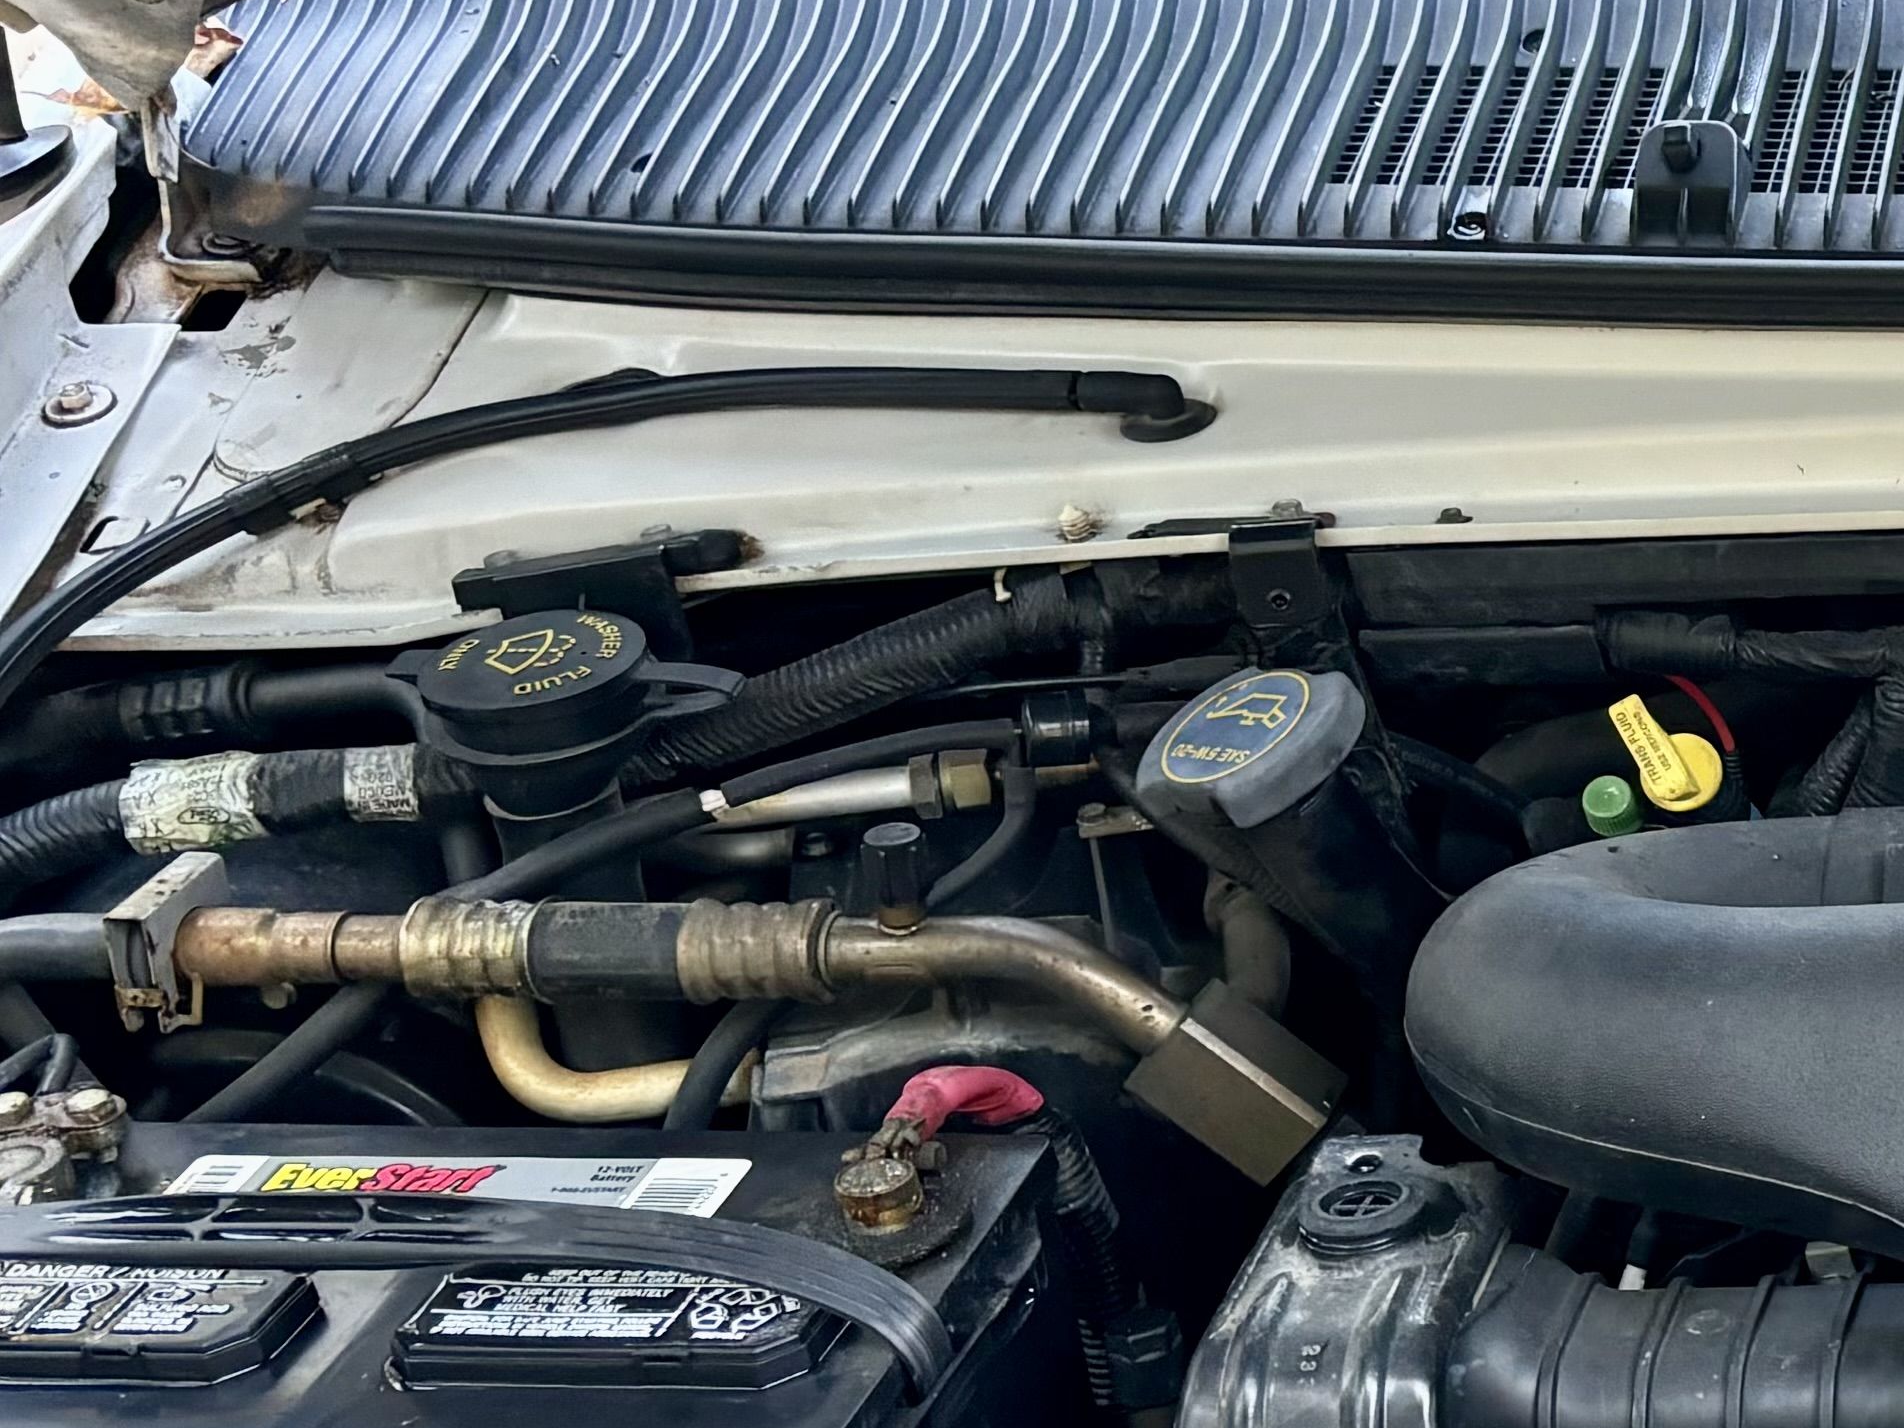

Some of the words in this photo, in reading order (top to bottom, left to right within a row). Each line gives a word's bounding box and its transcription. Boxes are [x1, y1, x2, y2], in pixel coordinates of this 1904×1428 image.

[577, 614, 623, 660] WASHER
[437, 638, 481, 671] ONLY
[513, 665, 592, 696] FLUID
[1615, 711, 1638, 746] FLUID
[1170, 743, 1218, 762] 5W-20
[1216, 748, 1251, 764] SAE
[1634, 744, 1663, 785] TRANS
[258, 1162, 499, 1194] EverStart
[7, 1263, 115, 1278] DANGER
